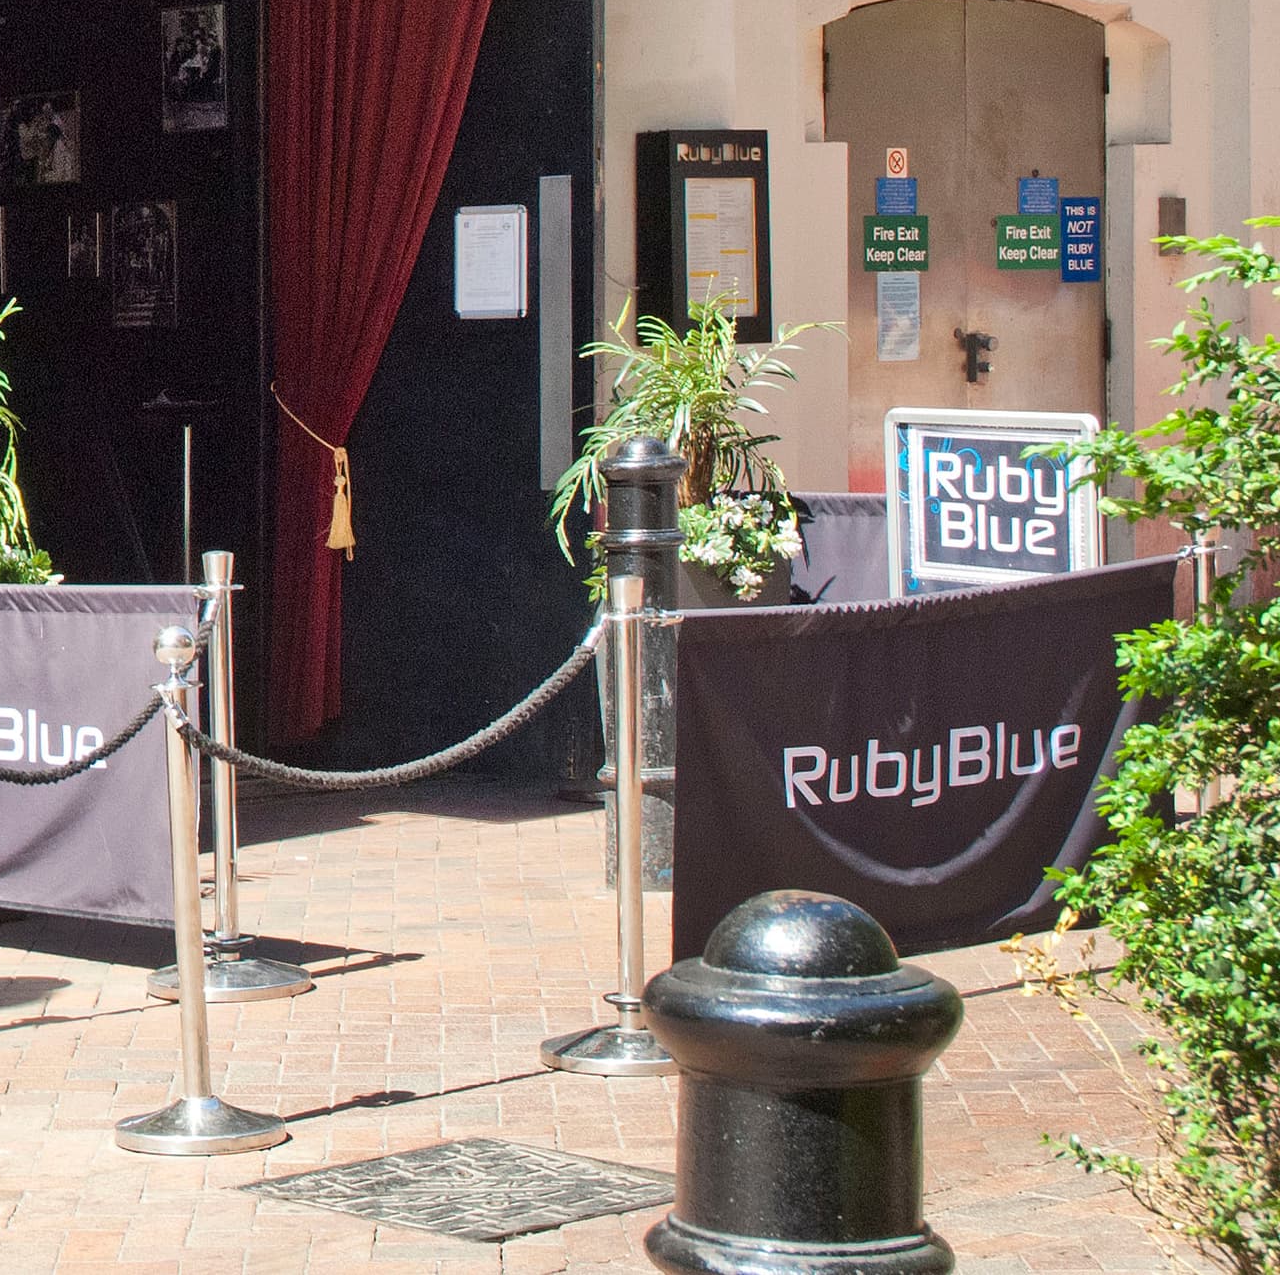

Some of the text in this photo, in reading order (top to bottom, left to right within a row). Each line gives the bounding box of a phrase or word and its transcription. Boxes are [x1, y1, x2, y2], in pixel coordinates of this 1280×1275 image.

[676, 143, 762, 165] RubyBlue
[1065, 206, 1096, 216] THIS IS
[873, 227, 919, 241] Fire Exit
[1006, 226, 1052, 240] Fire Exit
[1067, 221, 1095, 233] NOT
[866, 247, 926, 265] Keep Clear
[999, 246, 1058, 263] Keep Clear
[1067, 244, 1094, 255] RUBY
[1068, 259, 1094, 270] BLUE
[928, 452, 1064, 516] Ruby
[940, 501, 1056, 556] Blue
[784, 722, 1082, 808] RubyBlue
